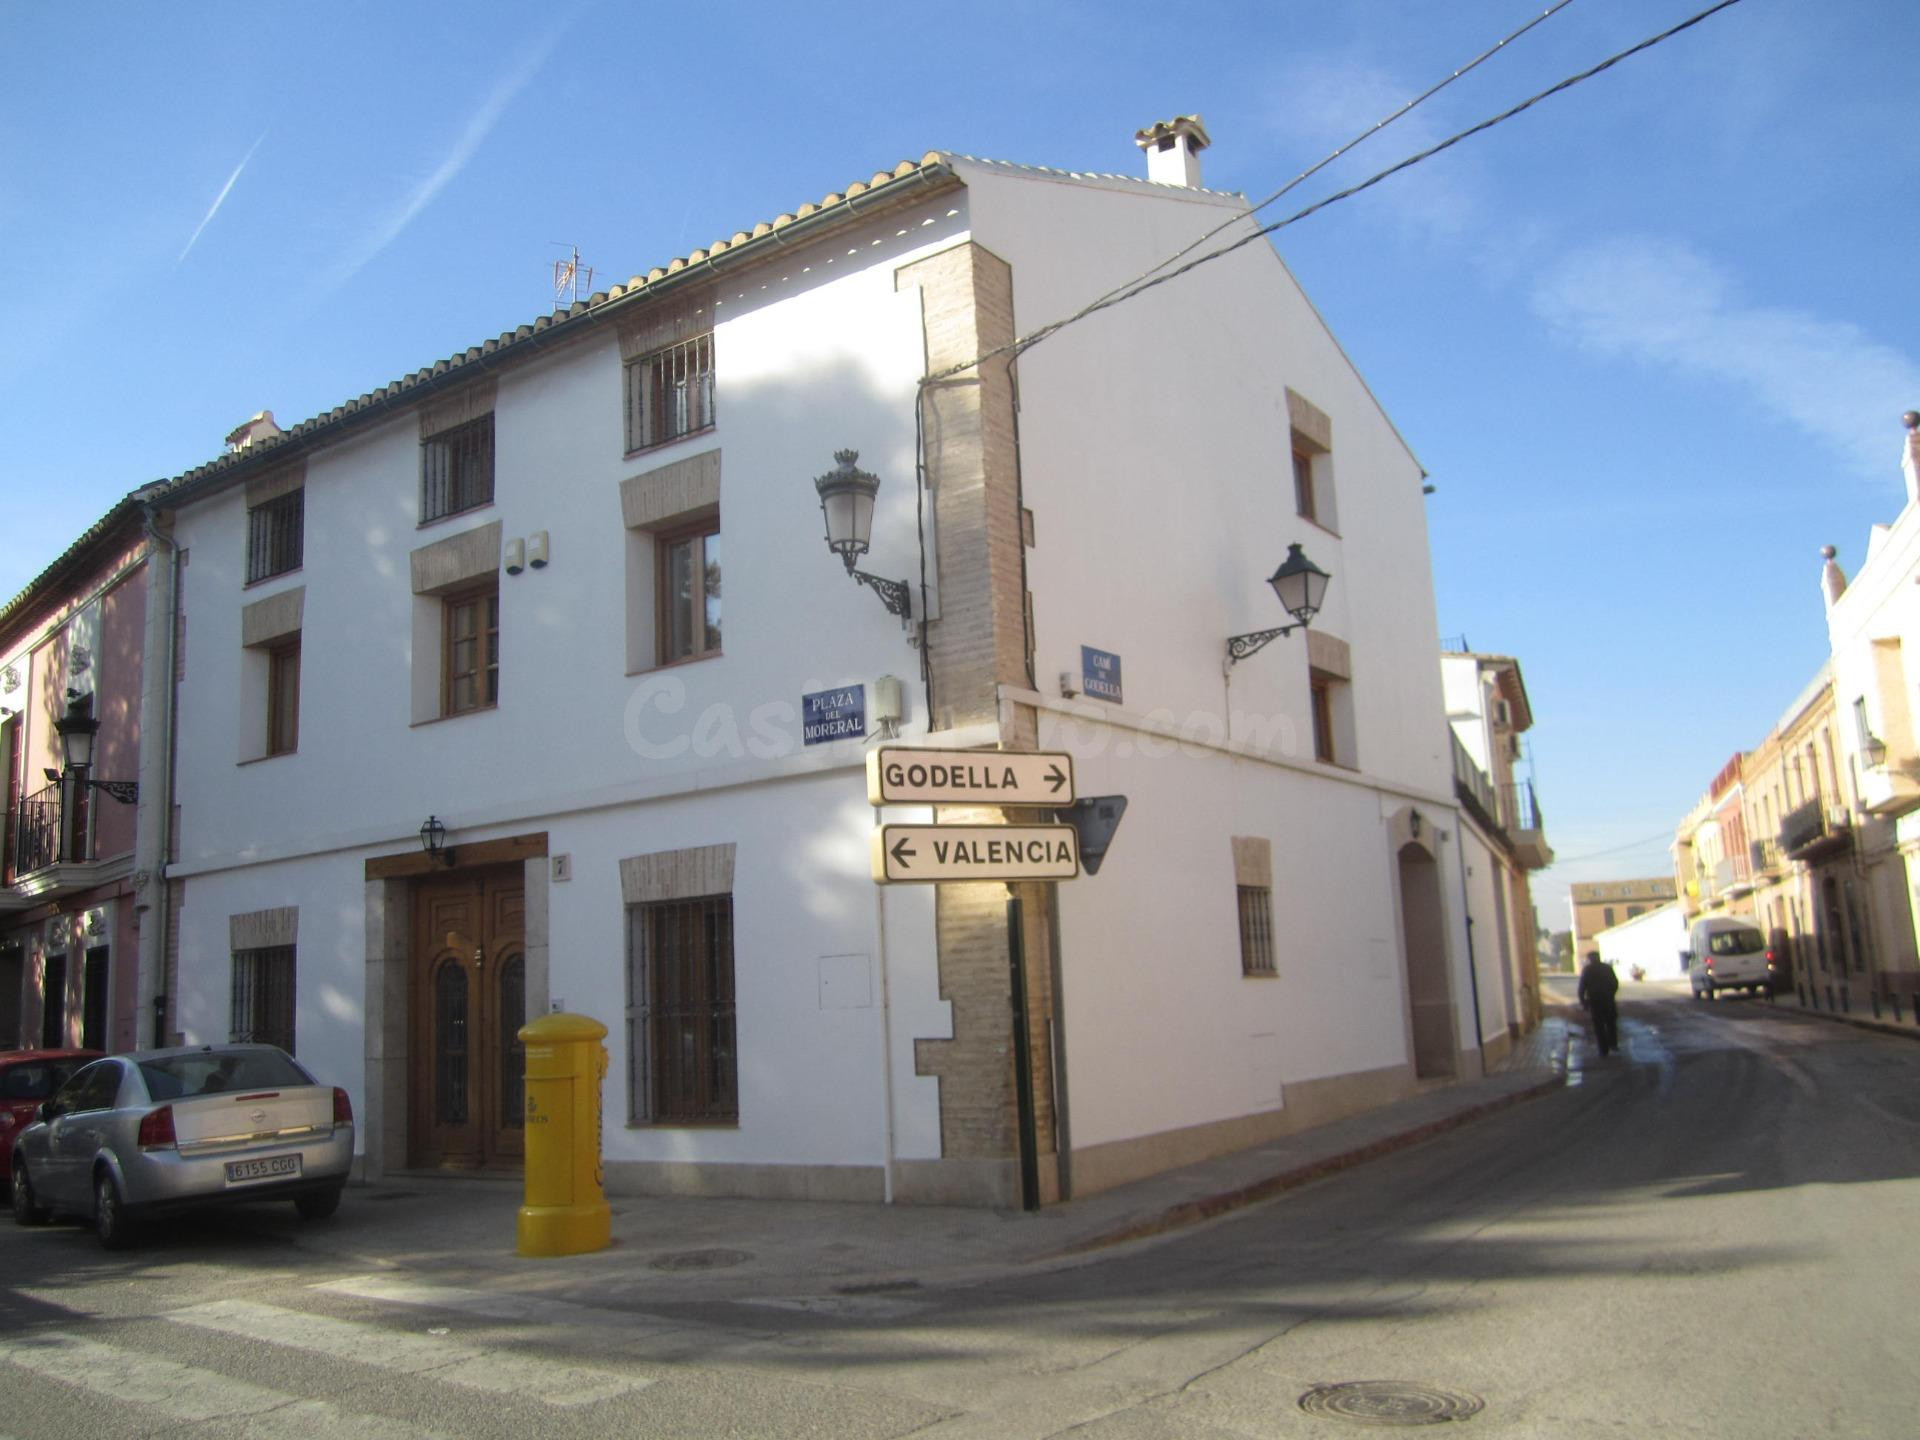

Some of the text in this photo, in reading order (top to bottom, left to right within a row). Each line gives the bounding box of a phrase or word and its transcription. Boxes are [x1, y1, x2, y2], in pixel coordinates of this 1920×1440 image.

[812, 692, 854, 712] PLAZA
[825, 710, 841, 721] DEL
[805, 718, 863, 740] MORERAL
[885, 763, 1019, 790] GODELLA
[932, 839, 1073, 864] VALENCIA
[235, 1162, 268, 1177] 6155
